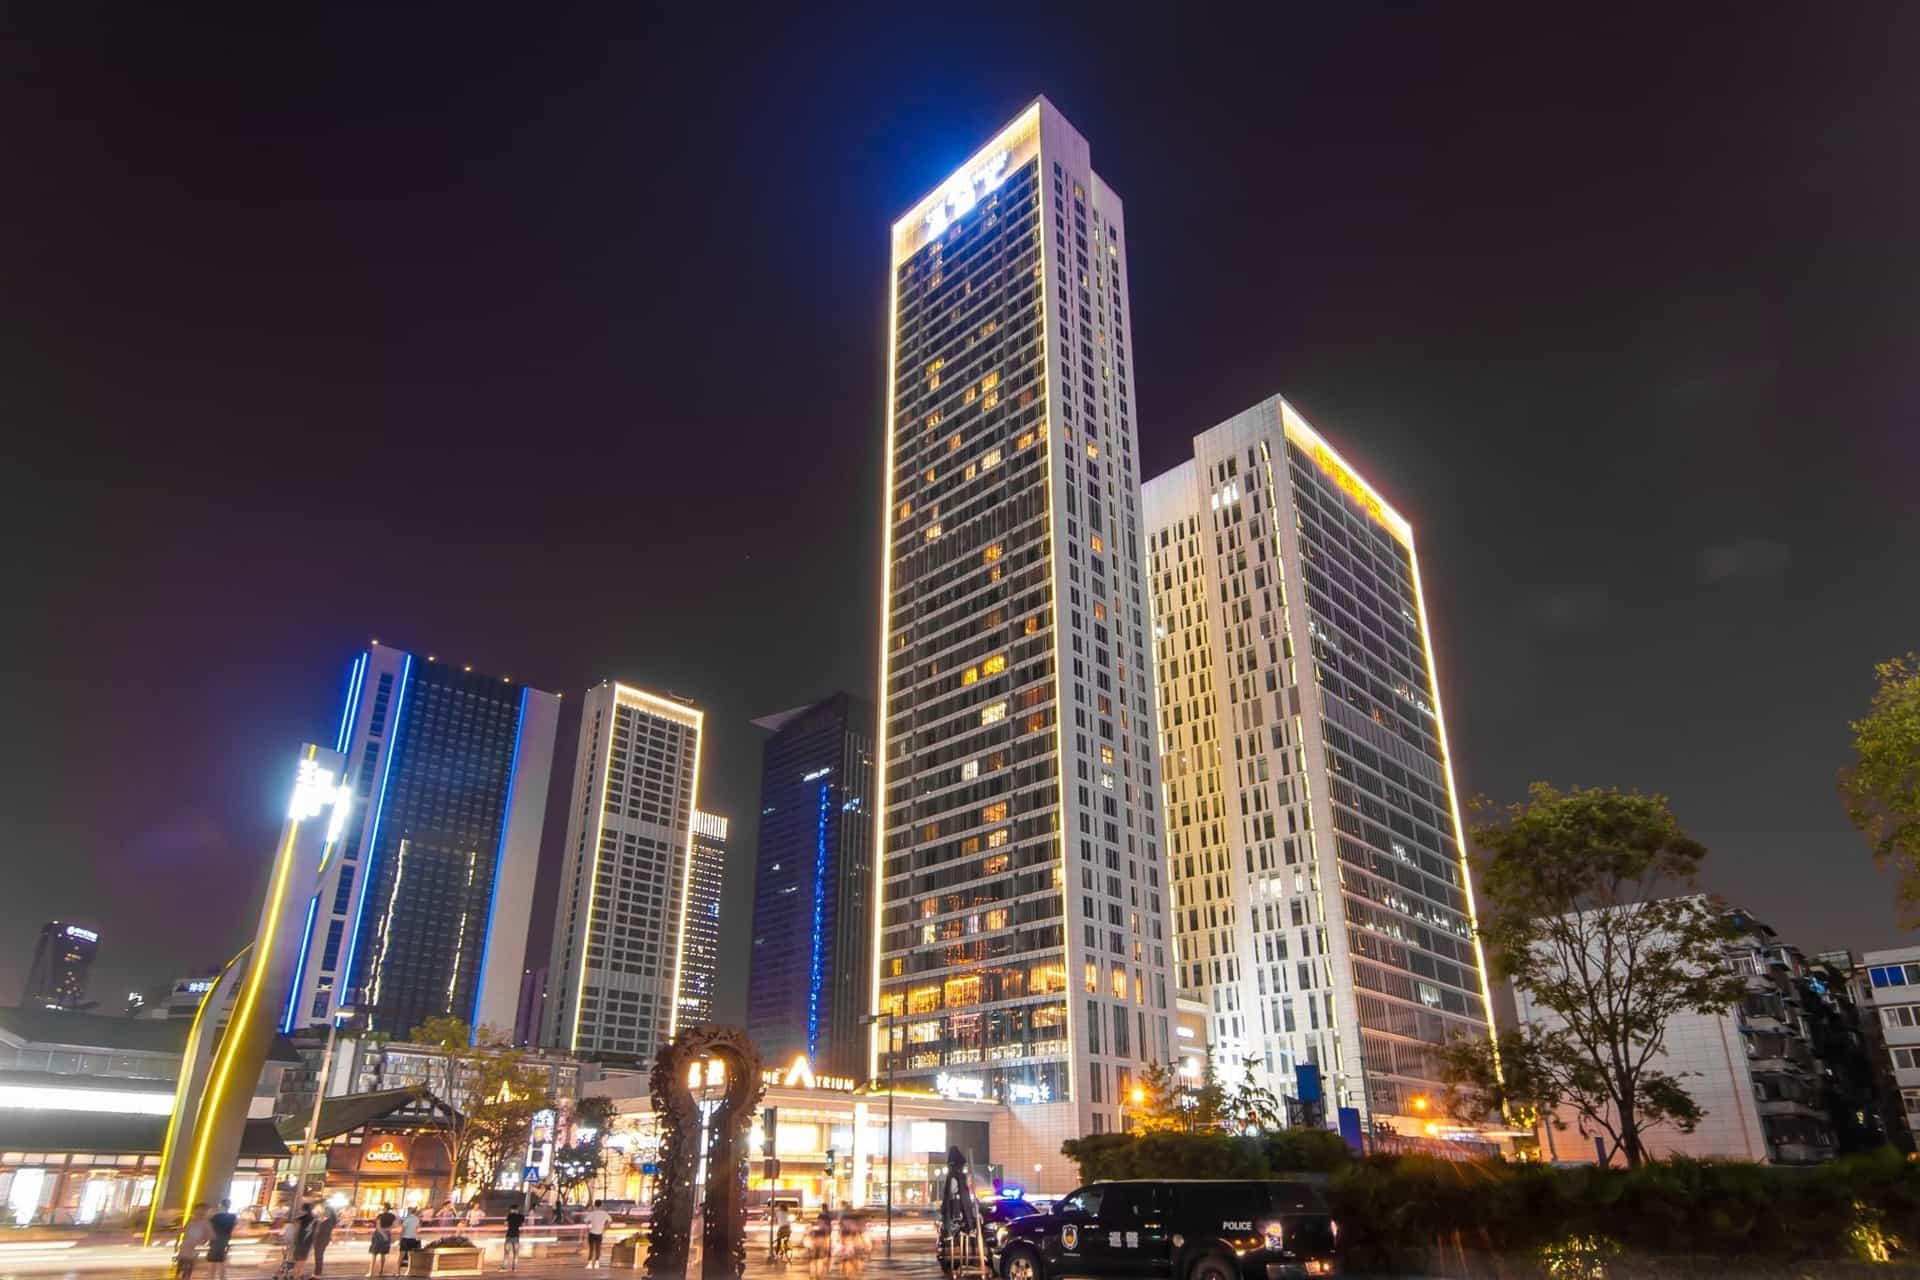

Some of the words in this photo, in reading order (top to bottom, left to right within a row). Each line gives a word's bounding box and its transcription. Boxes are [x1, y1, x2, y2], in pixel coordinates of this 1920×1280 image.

[762, 1071, 779, 1085] HE
[784, 1055, 854, 1090] ATRIUM
[367, 1151, 404, 1161] OMEGA
[1223, 1220, 1252, 1231] POLICE
